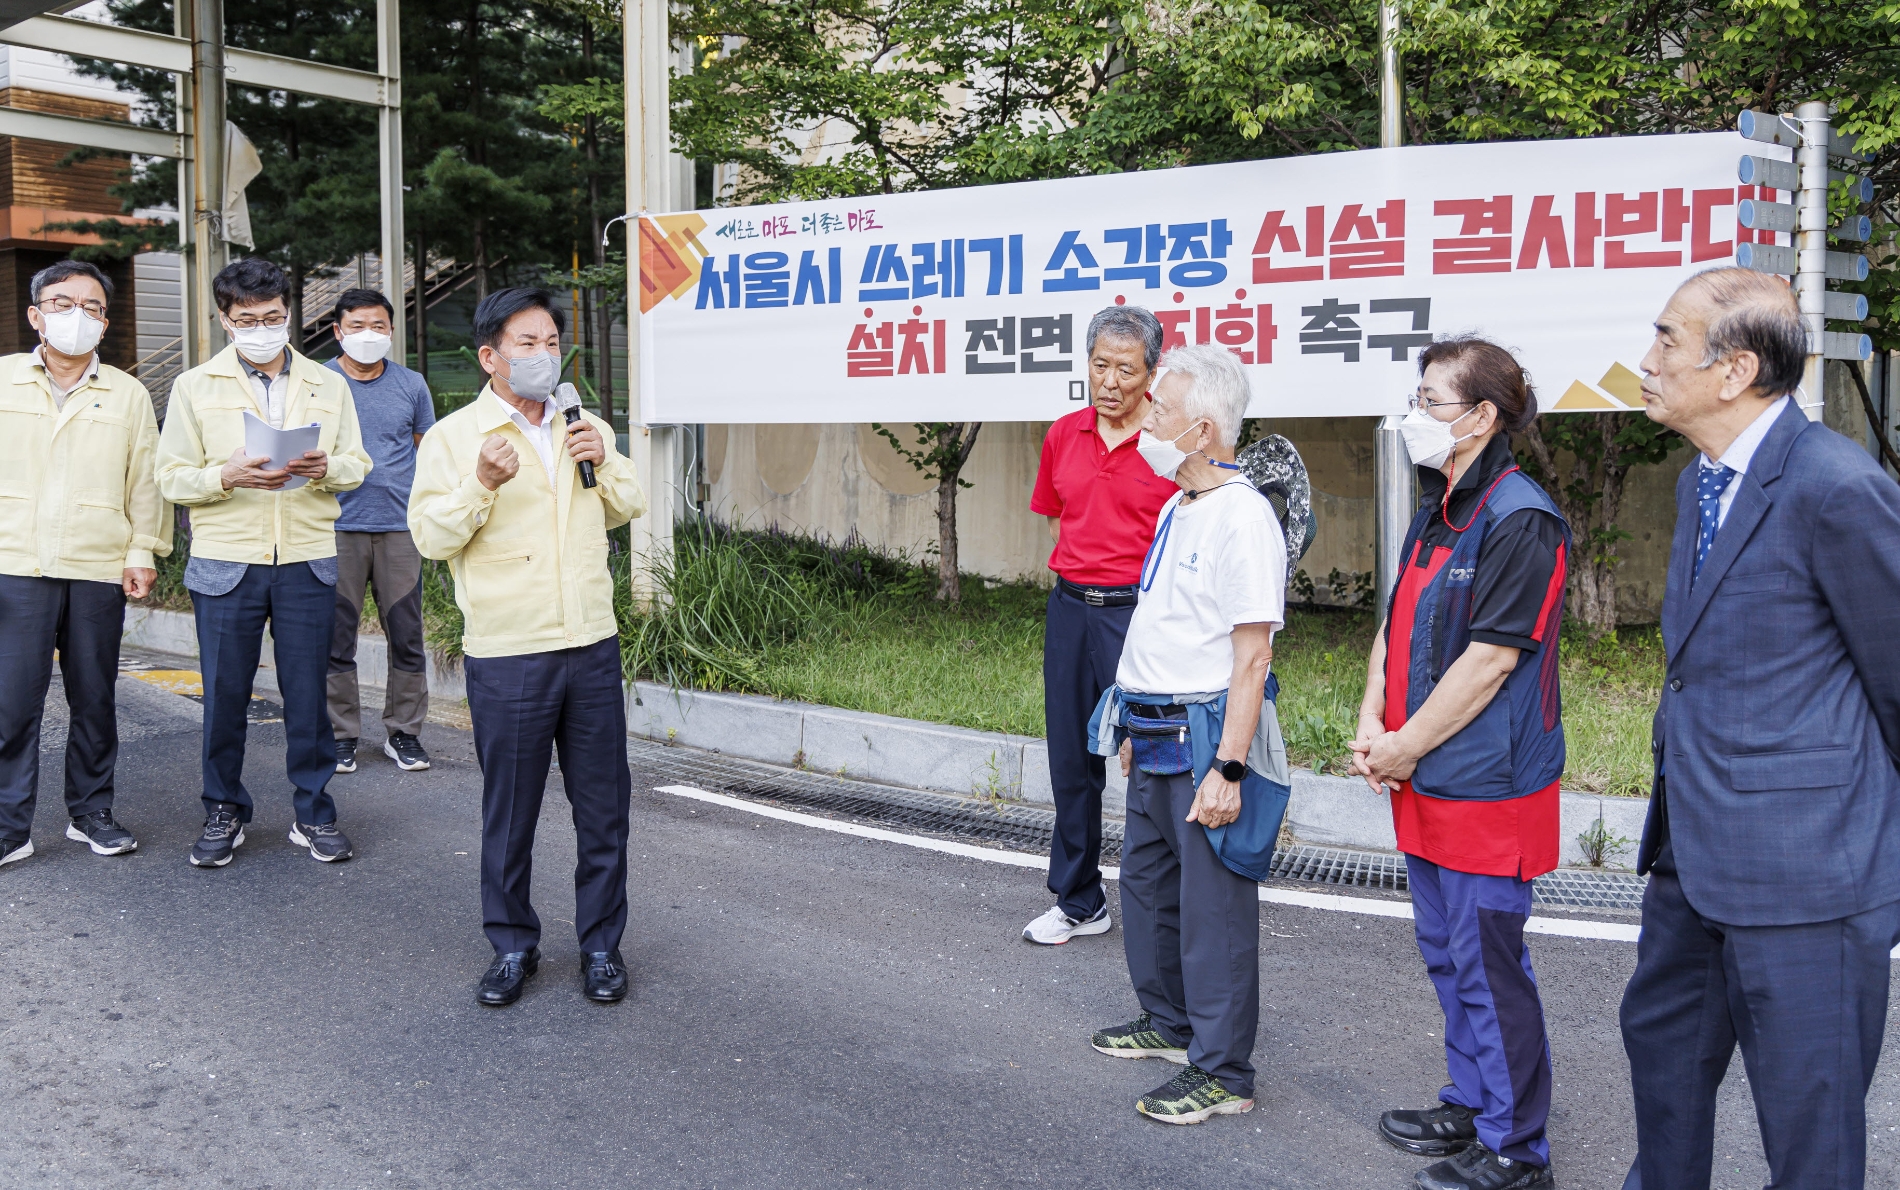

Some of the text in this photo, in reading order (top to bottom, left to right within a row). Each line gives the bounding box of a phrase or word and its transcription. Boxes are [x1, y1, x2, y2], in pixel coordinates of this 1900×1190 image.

[694, 247, 842, 310] 서울시
[858, 234, 1023, 303] 쓰레기
[1042, 218, 1233, 293] 소각장
[1251, 199, 1406, 284] 신설
[715, 209, 884, 242] 새로운 마포 더 좋은 마포
[847, 318, 946, 378] 설치
[965, 313, 1073, 375] 전면
[1299, 297, 1434, 363] 촉구
